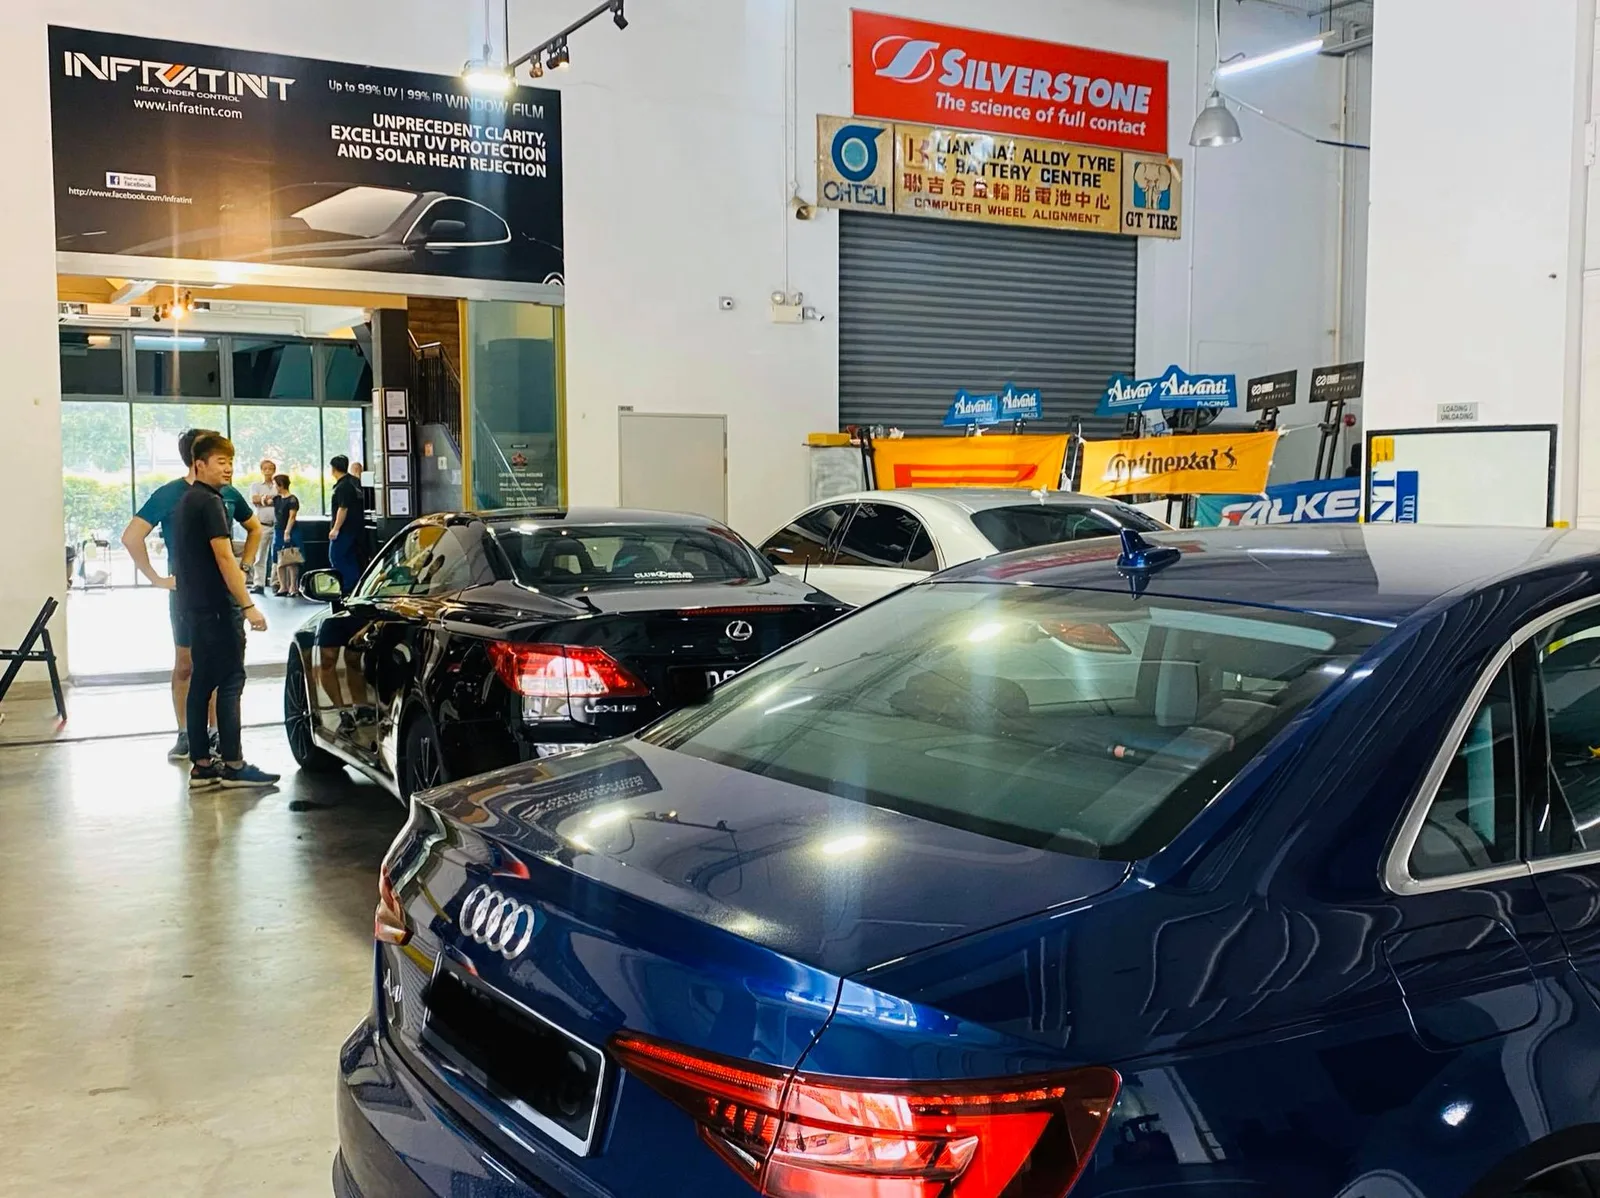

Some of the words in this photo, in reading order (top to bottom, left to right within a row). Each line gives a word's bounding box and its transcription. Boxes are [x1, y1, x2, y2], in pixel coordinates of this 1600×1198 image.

[64, 51, 296, 101] INFRATINT
[938, 47, 1152, 115] SILVERSTONE
[136, 84, 160, 94] HEAT
[162, 88, 195, 98] UNDER
[196, 92, 240, 102] CONTROL
[328, 79, 342, 93] Up
[344, 81, 355, 93] to
[357, 83, 381, 96] 99%
[383, 86, 398, 98] UV
[407, 89, 430, 101] 99%
[432, 92, 443, 103] IR
[444, 93, 509, 113] WINDOW
[512, 102, 544, 119] FILM
[133, 98, 243, 119] www.infratint.com
[935, 91, 966, 111] The
[970, 98, 1030, 121] science
[1035, 105, 1054, 123] of
[1058, 108, 1085, 128] full
[1090, 115, 1146, 137] contact
[373, 113, 482, 138] UNPRECEDENT
[484, 126, 546, 147] CLARITY,
[331, 125, 421, 149] EXCELLENT
[424, 135, 447, 151] UV
[450, 137, 546, 162] PROTECTION
[337, 143, 373, 160] AND
[375, 147, 426, 166] SOLAR
[428, 152, 467, 169] HEAT
[470, 155, 547, 178] REJECTION
[956, 158, 1032, 181] BATTERY
[1041, 168, 1102, 188] CENTRE
[1023, 148, 1071, 167] ALLOY
[1078, 154, 1116, 173] TYRE
[68, 187, 193, 205] http://www.facebook.com/infratint
[823, 180, 886, 206] OHTSU
[914, 197, 981, 214] COMPUTER
[987, 205, 1026, 218] WHEEL
[1033, 209, 1100, 225] ALIGNMENT
[1125, 211, 1143, 228] GT
[1147, 213, 1178, 231] TIRE
[1107, 379, 1155, 402] Advan
[1160, 372, 1228, 396] Advanti
[954, 395, 993, 415] Advanti
[1002, 388, 1038, 409] Advanti
[1442, 405, 1468, 413] LOADING
[1440, 412, 1474, 421] UNLOADING
[1107, 448, 1218, 483] Continental
[1218, 489, 1361, 527] FALKE
